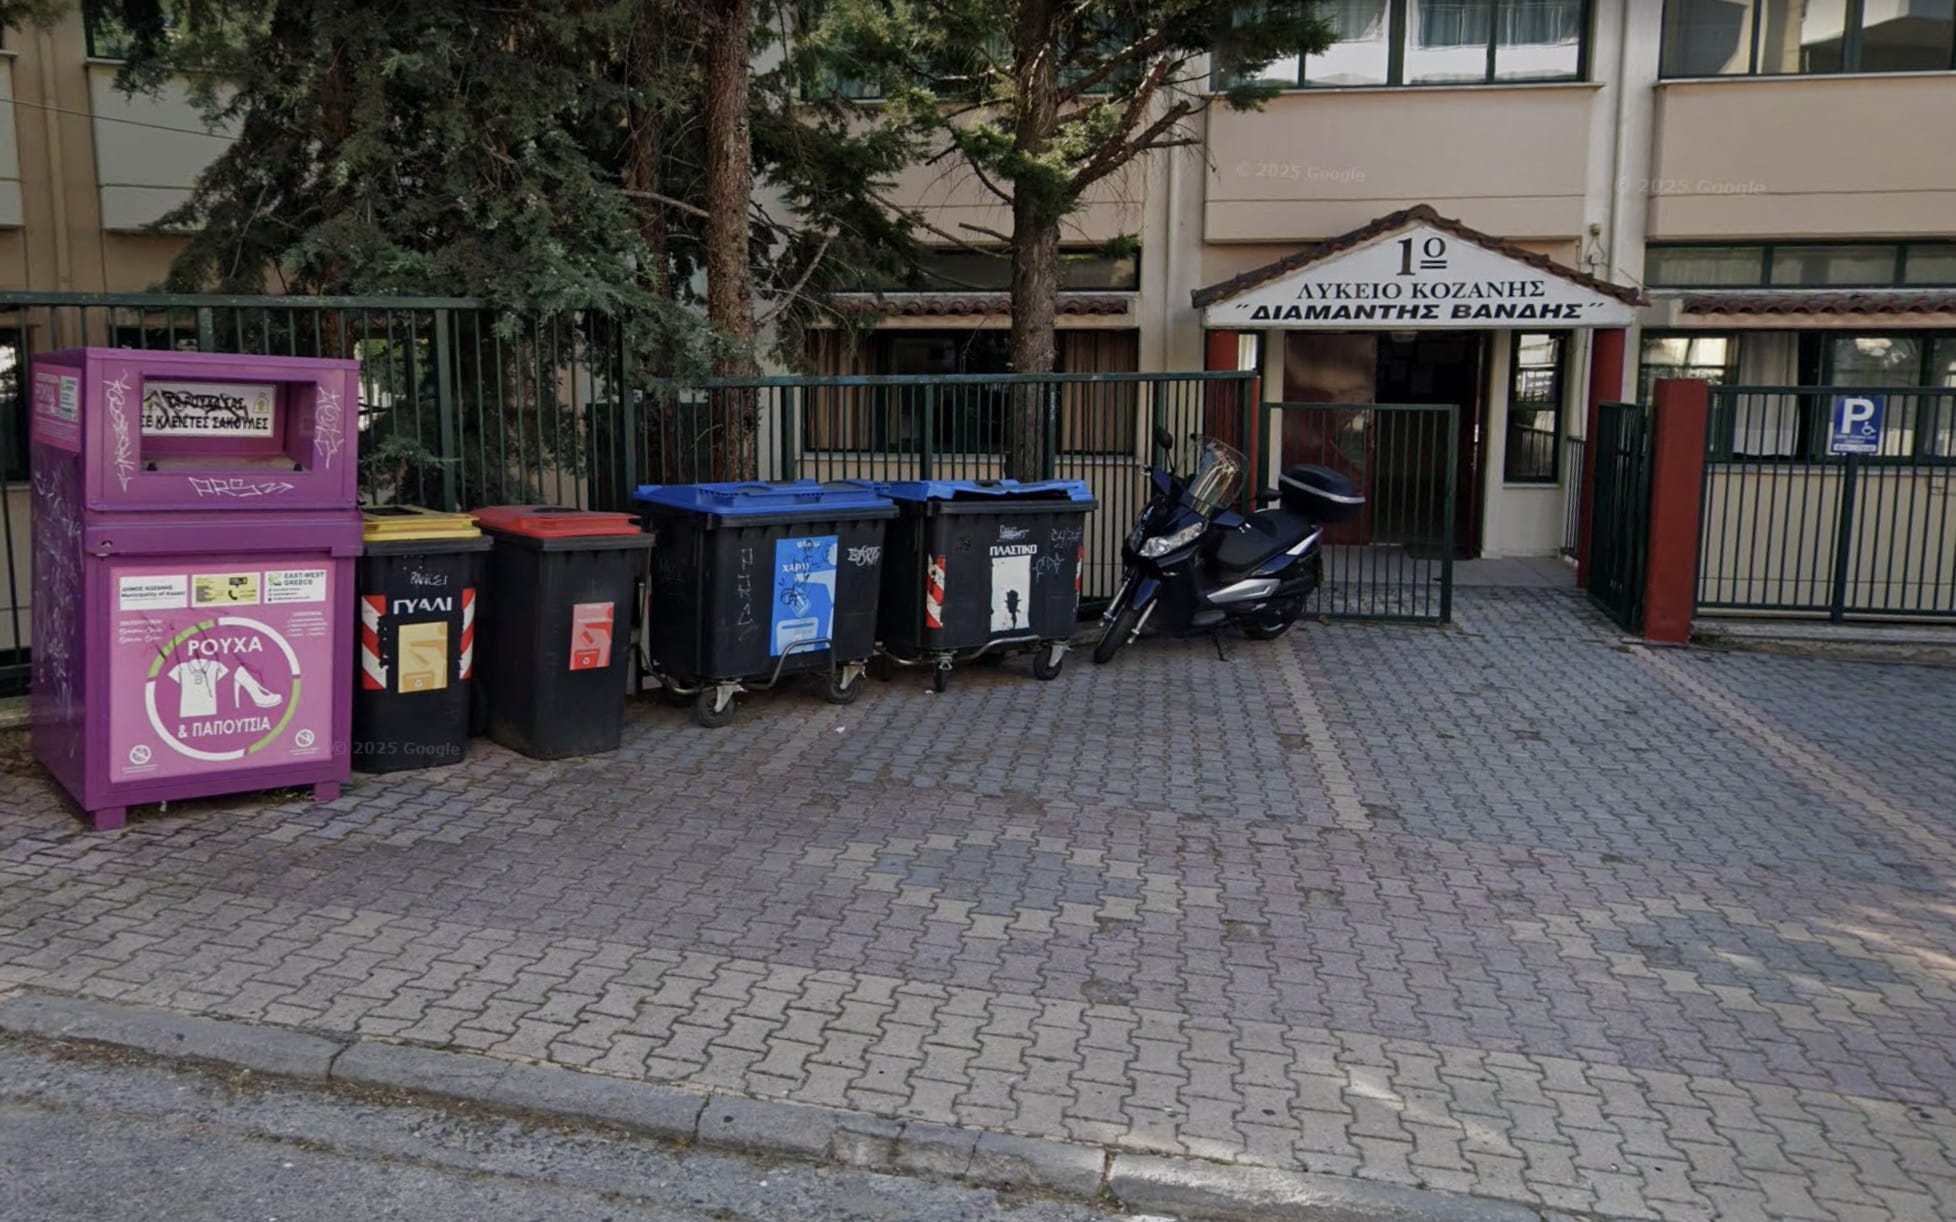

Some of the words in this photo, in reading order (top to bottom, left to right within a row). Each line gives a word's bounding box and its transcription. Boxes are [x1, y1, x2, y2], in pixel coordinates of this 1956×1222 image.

[1296, 282, 1403, 300] ΛΥΚΕΙΟ
[1412, 280, 1545, 300] ΚΟΖΑΝΗΣ
[1841, 398, 1875, 435] P
[990, 544, 1038, 556] ΠΛΑΣΤΙΚΟ
[393, 596, 452, 615] ΓΥΑΛΙ
[187, 636, 263, 656] ΡΟΥΧΑ
[177, 724, 188, 739] &
[192, 716, 271, 737] ΠΑΠΟΥΤΣΙΑ
